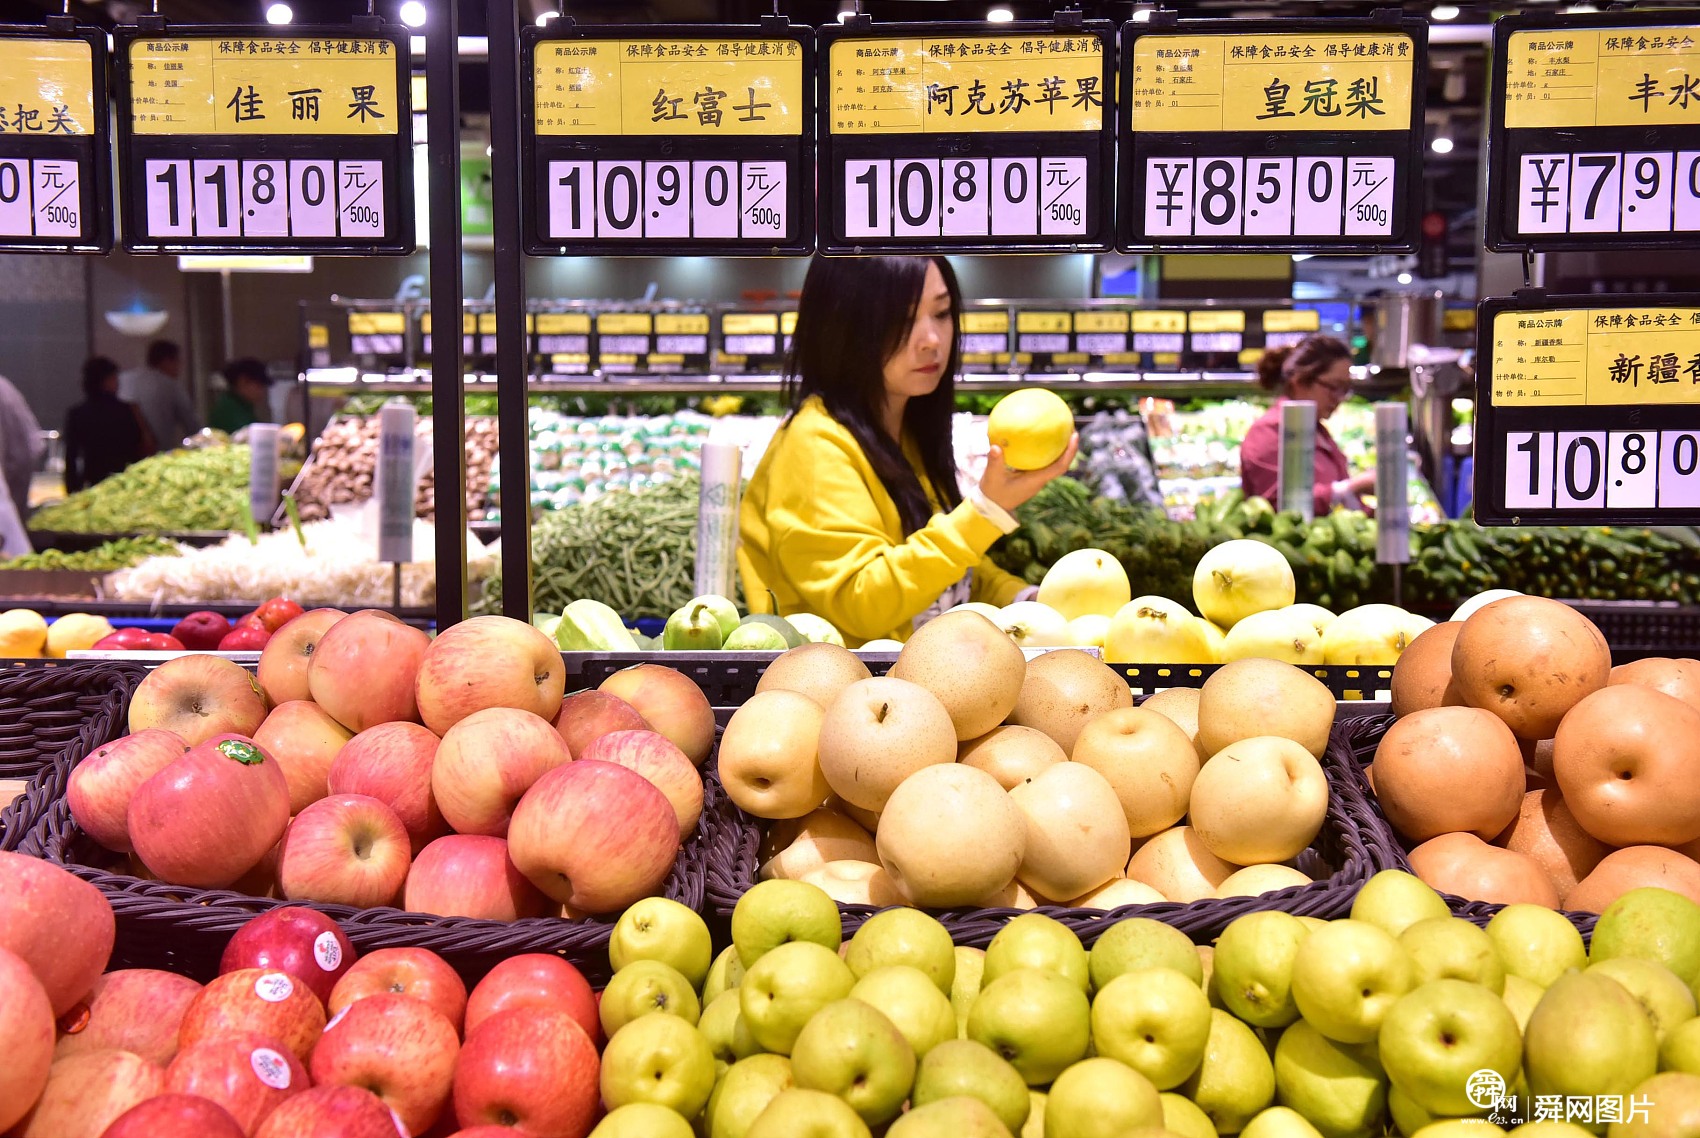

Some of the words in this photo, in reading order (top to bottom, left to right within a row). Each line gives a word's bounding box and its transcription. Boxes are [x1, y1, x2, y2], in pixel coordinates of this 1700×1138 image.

[146, 43, 189, 51] 商品公示牌
[218, 41, 301, 54] 保障食品安全
[308, 40, 390, 55] 倡导健康消费
[627, 44, 709, 57] 保障食品安全
[717, 43, 798, 57] 倡导健康消费
[929, 43, 1012, 57] 保障食品安全
[1020, 38, 1102, 54] 倡导健康消费
[1230, 44, 1316, 58] 保障食品安全
[1324, 42, 1410, 58] 倡导健康消费
[1529, 41, 1573, 50] 商品公示牌
[1605, 36, 1695, 51] 保障食品安全
[555, 48, 597, 56] 商品公示牌
[856, 48, 898, 57] 商品公示牌
[1156, 49, 1199, 58] 商品公示牌
[1172, 76, 1193, 84] 石家庄
[927, 76, 1102, 116] 阿克苏苹果
[1256, 76, 1386, 120] 皇冠梨
[226, 84, 385, 124] 佳丽果
[651, 87, 772, 127] 红富士
[0, 104, 76, 135] 把关
[156, 164, 326, 228] 11.80
[558, 165, 729, 230] 10.90
[856, 161, 1028, 228] 10.80
[1518, 319, 1563, 329] 商品公示牌
[1594, 313, 1682, 328] 保障食品安全
[1517, 433, 1699, 501] 10.80
